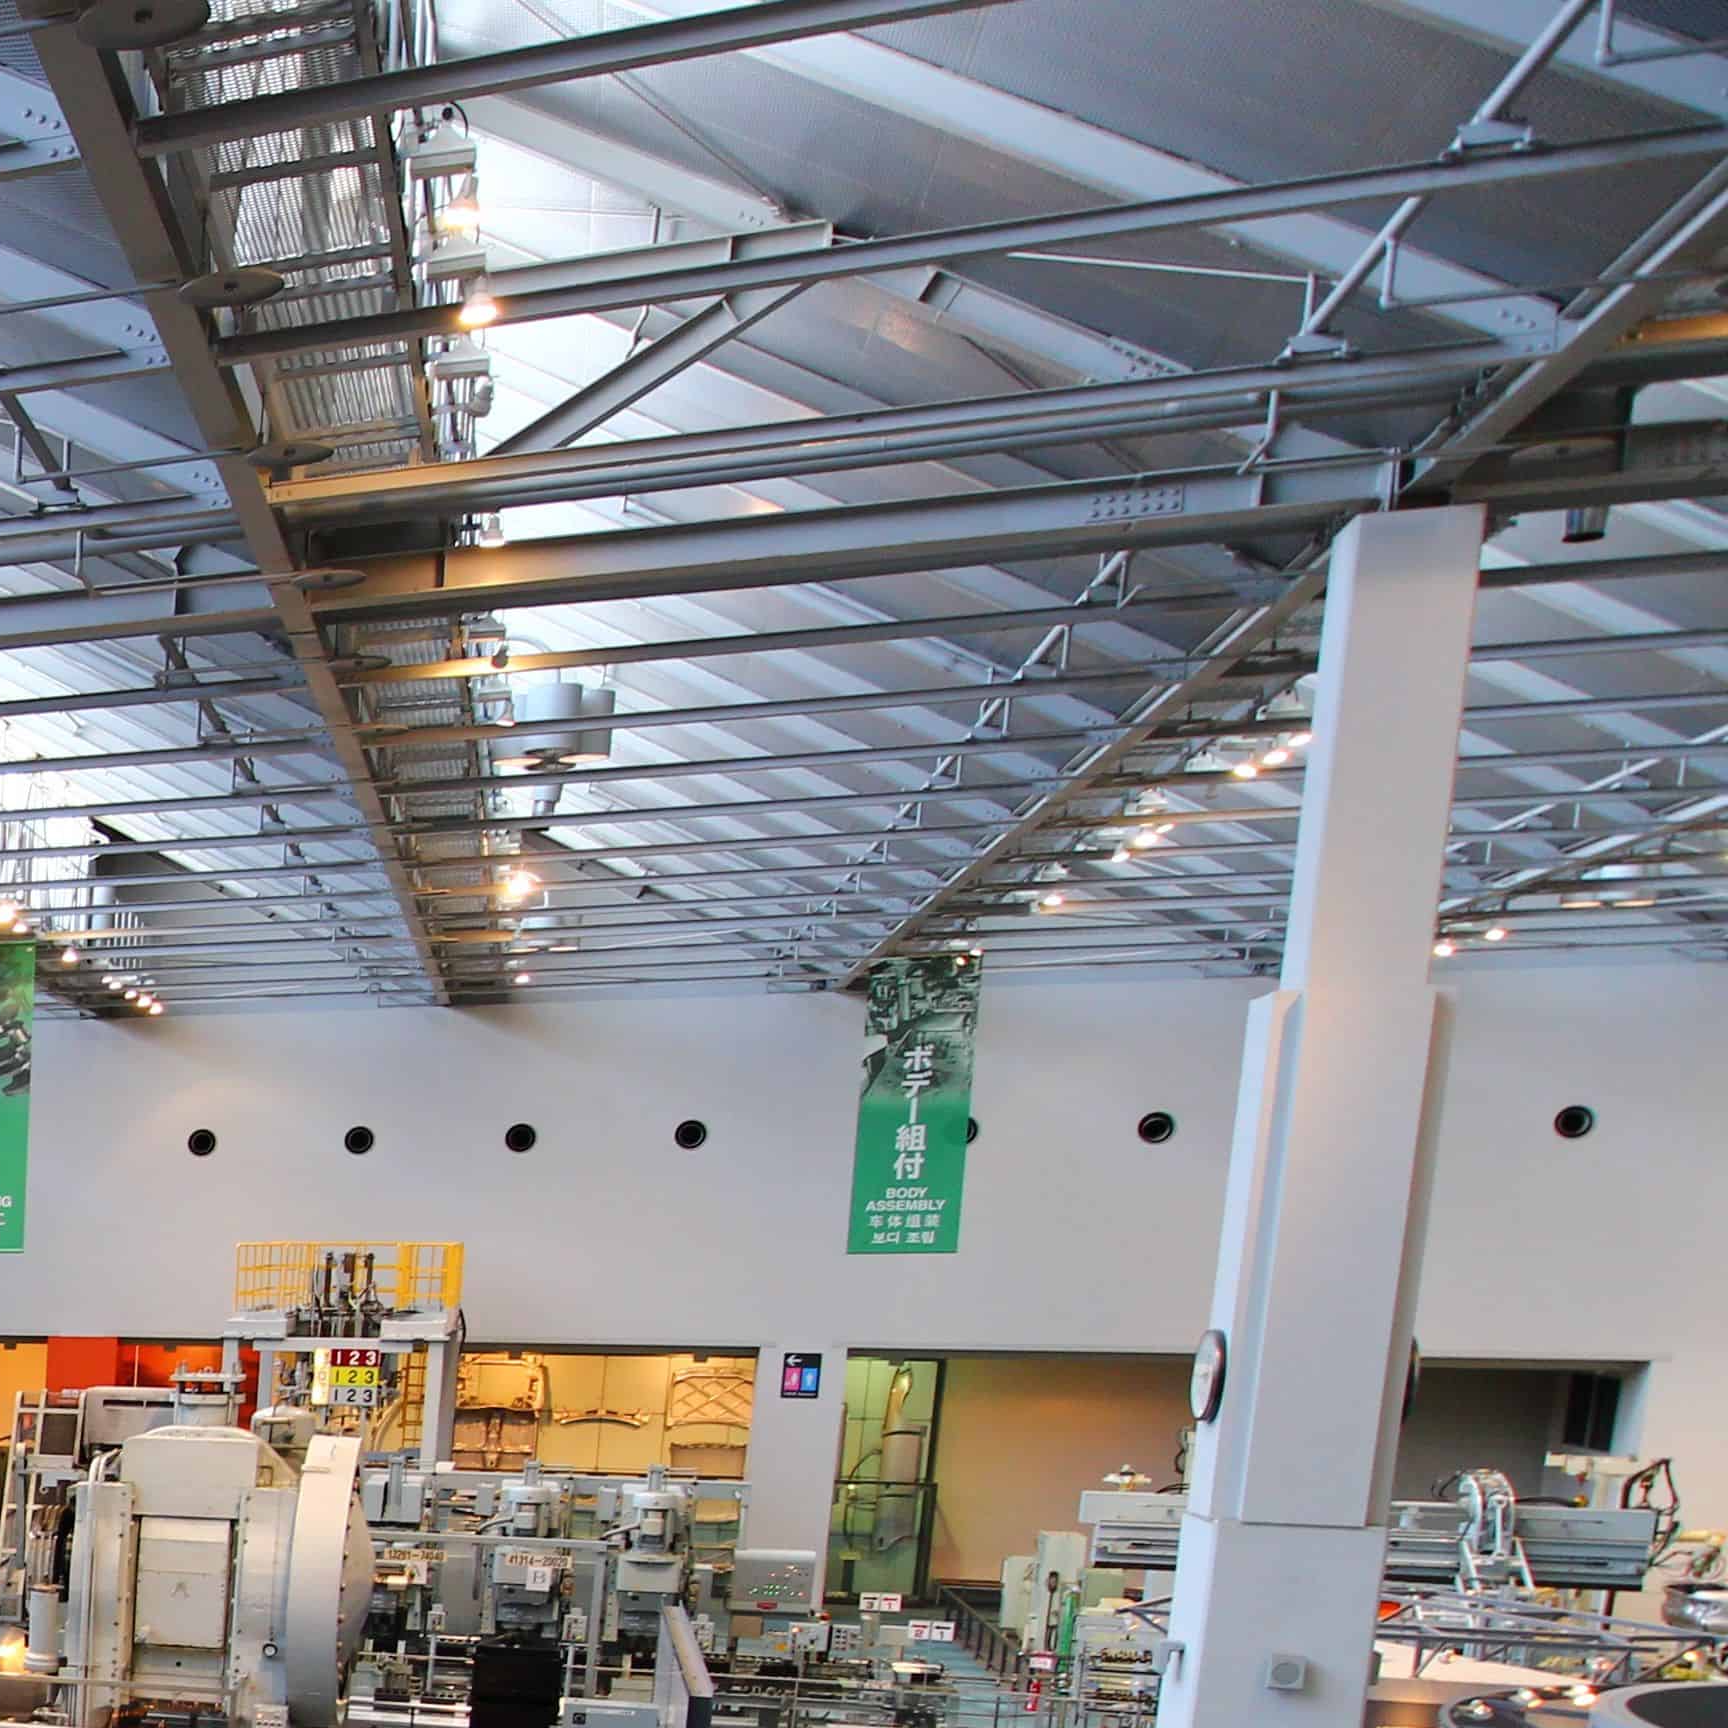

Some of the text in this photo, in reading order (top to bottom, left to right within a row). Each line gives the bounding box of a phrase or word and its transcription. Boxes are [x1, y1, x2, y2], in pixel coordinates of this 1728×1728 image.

[893, 1043, 935, 1180] ボデー組付
[885, 1187, 929, 1199] BODY
[865, 1199, 946, 1211] ASSEMBLY
[348, 1350, 361, 1366] 2
[365, 1350, 377, 1366] 3
[347, 1369, 358, 1383] 2
[364, 1370, 375, 1384] 3
[346, 1388, 357, 1402] 2
[363, 1389, 373, 1403] 3
